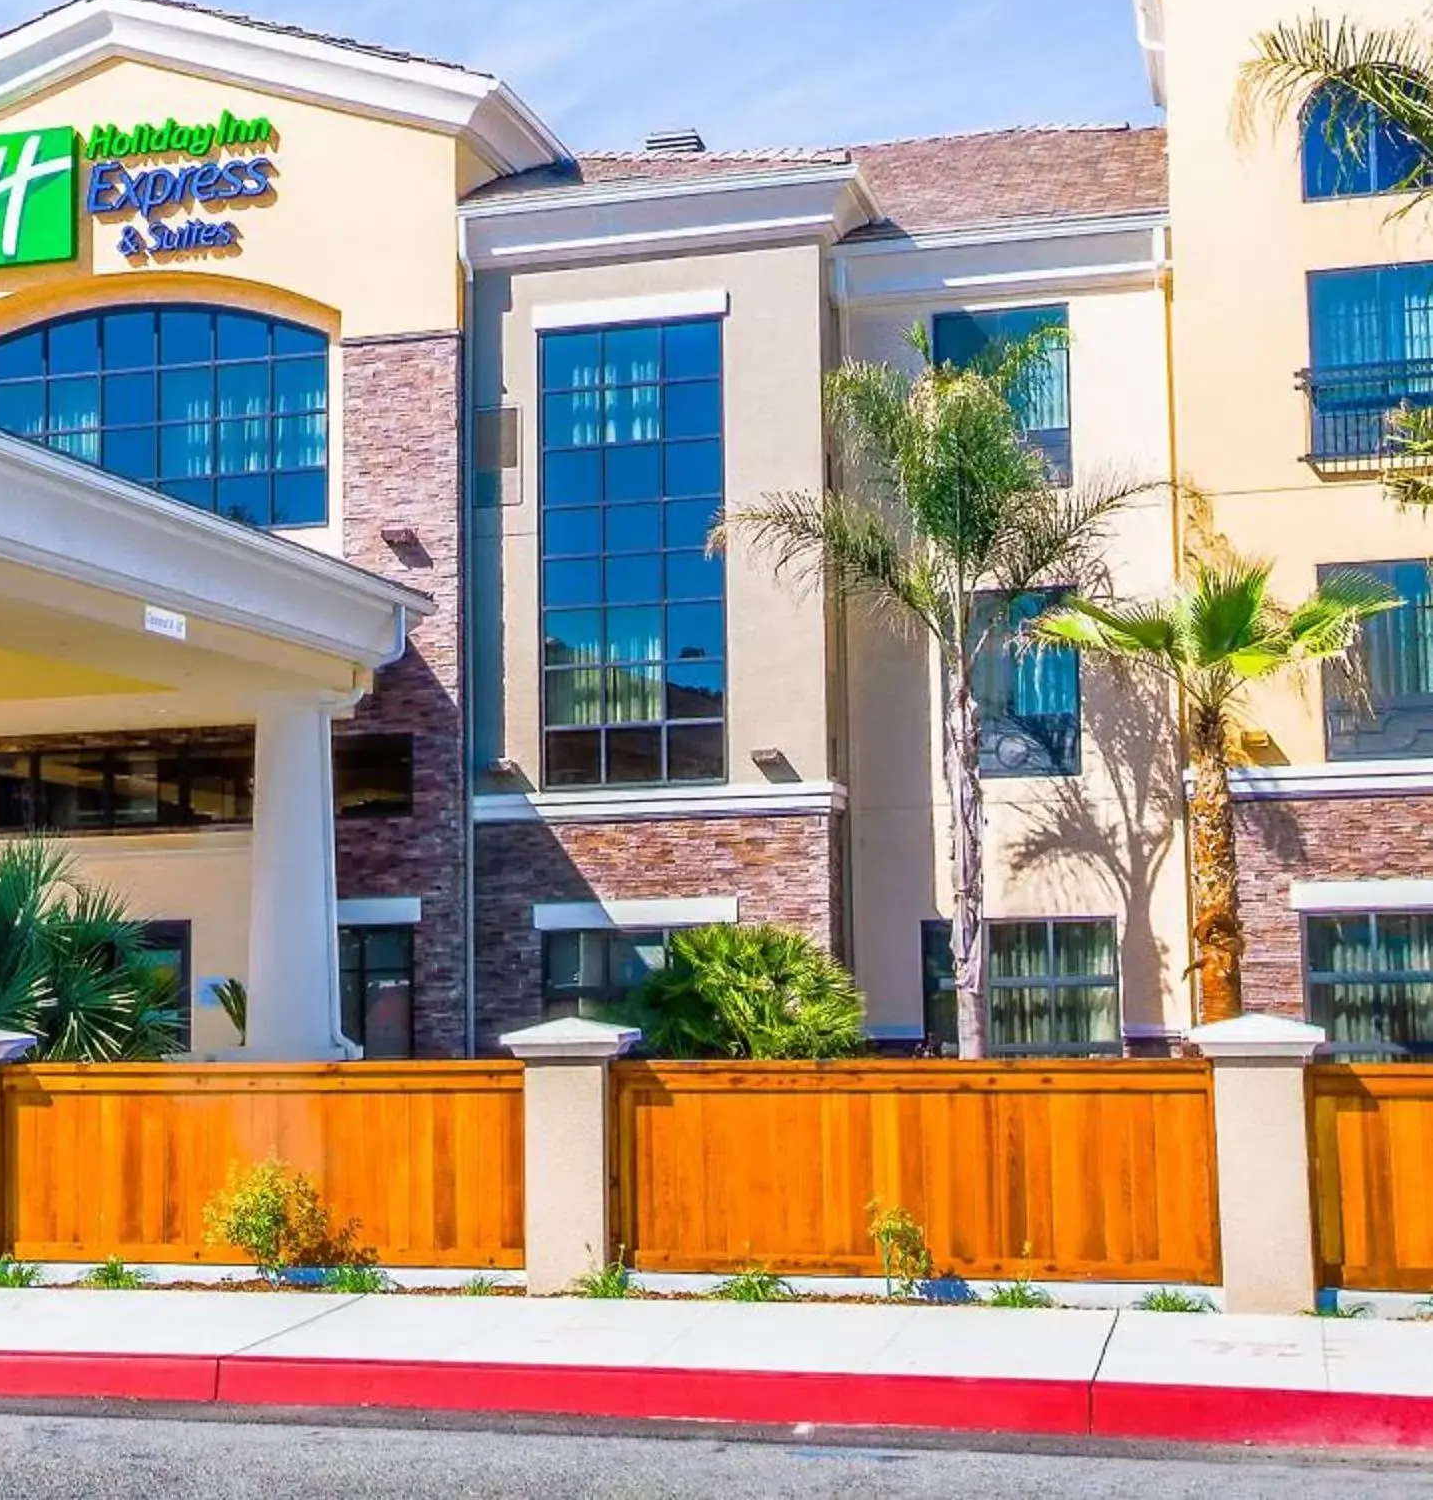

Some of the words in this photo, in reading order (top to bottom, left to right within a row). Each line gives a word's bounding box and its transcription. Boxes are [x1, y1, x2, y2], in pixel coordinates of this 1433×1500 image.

[85, 117, 215, 160] Holiday
[216, 108, 271, 146] Inn
[86, 157, 271, 221] Express
[117, 225, 140, 257] &
[147, 218, 233, 253] Suites
